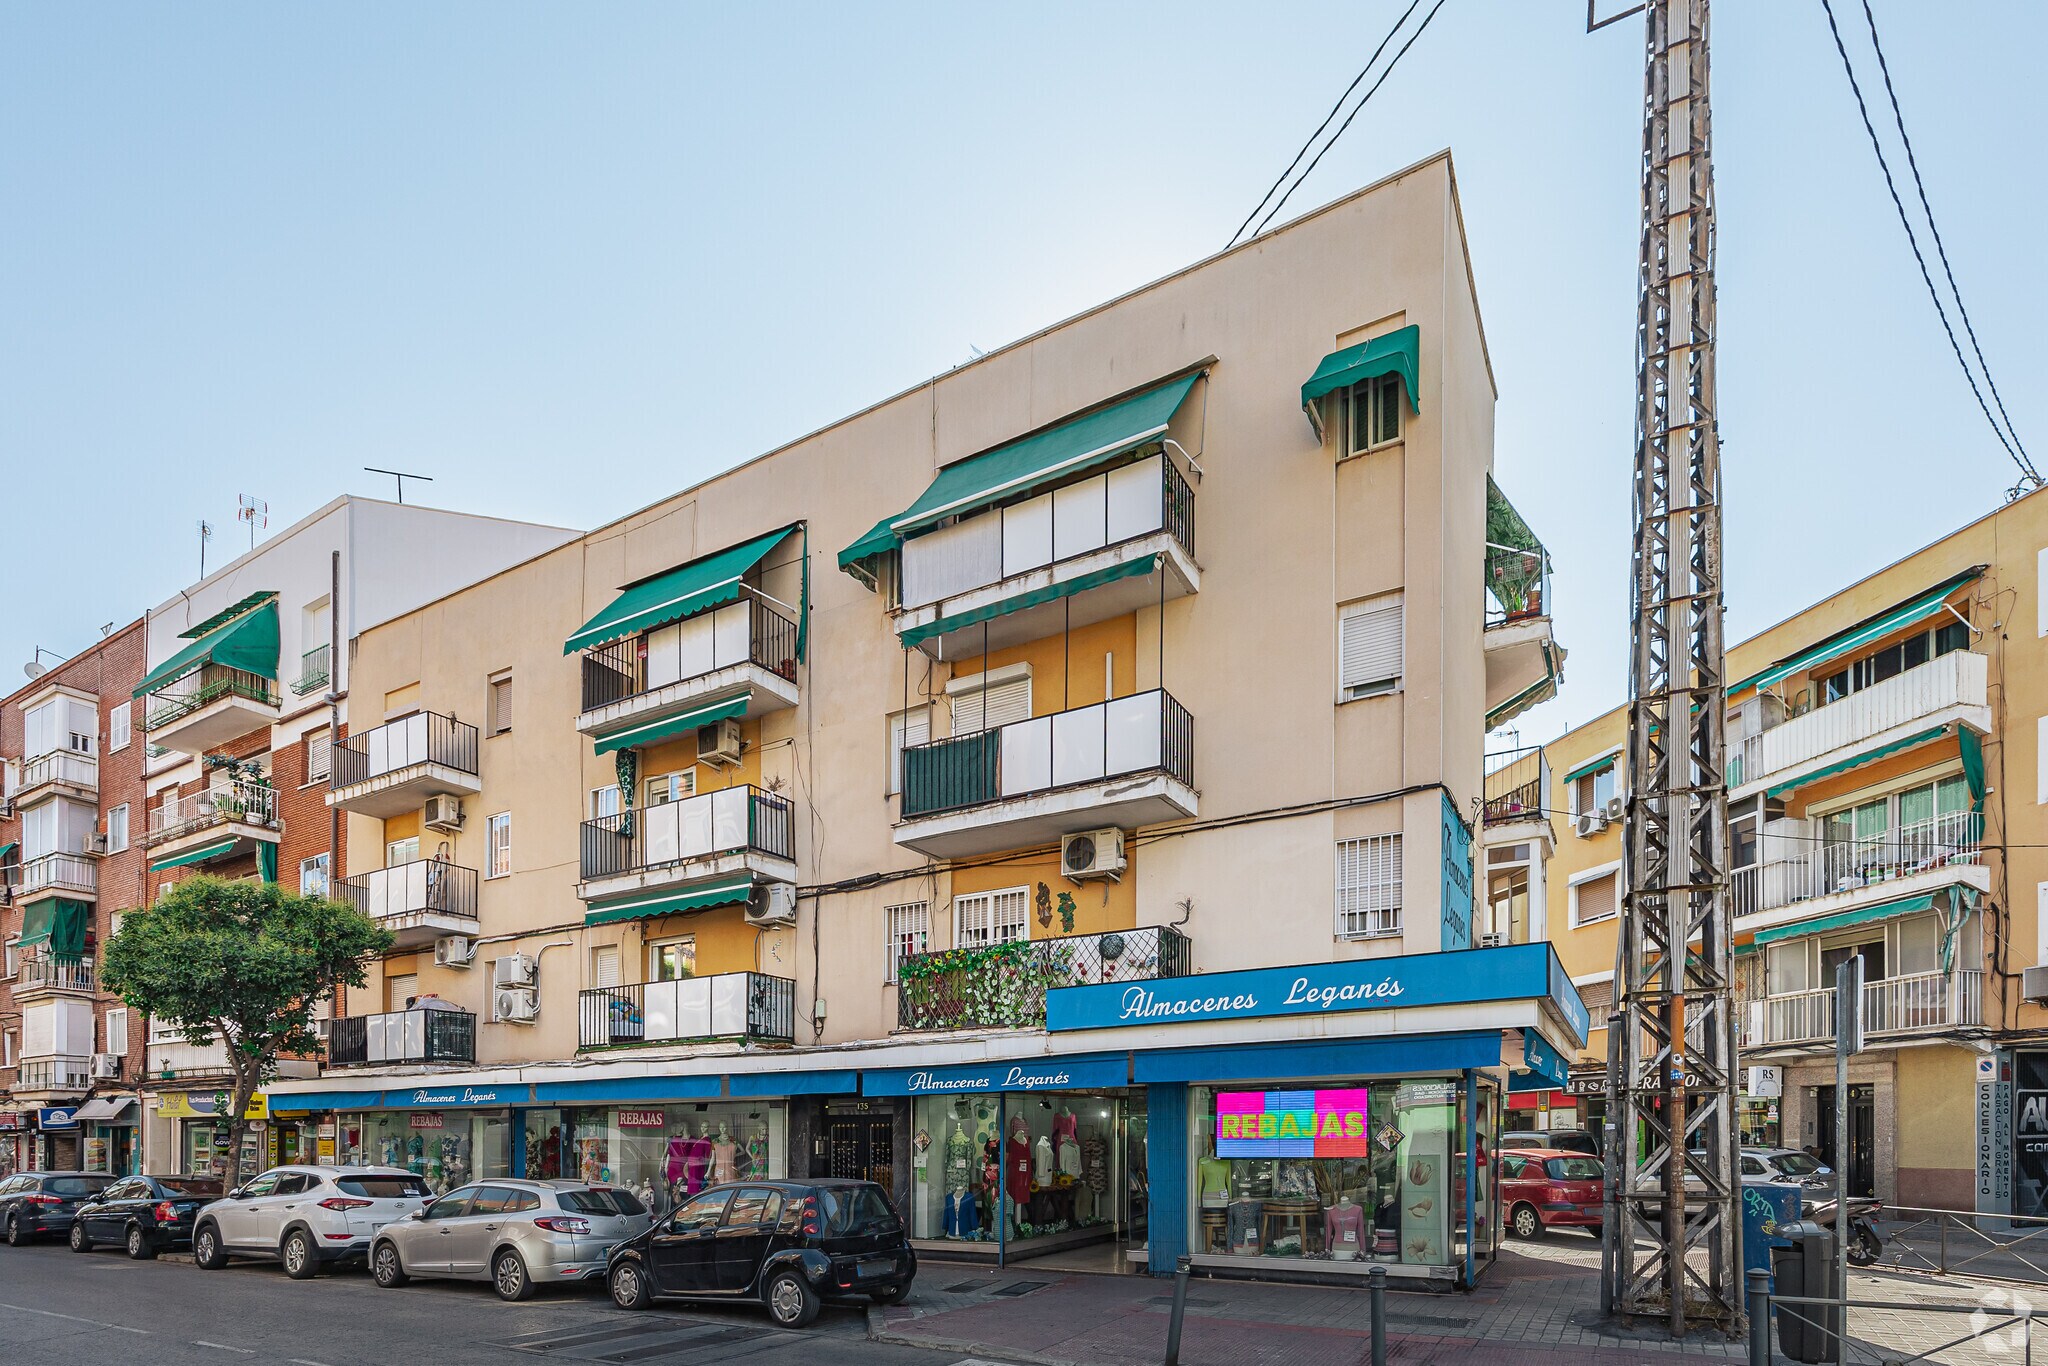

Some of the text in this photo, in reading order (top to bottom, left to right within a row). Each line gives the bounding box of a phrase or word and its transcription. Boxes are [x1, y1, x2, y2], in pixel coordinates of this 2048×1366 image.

[1119, 976, 1405, 1019] Almacenes Leganés
[908, 1066, 1069, 1091] Almacenes Leganés
[1762, 1069, 1774, 1080] RS
[413, 1087, 496, 1104] Almacenes Leganés
[857, 1102, 869, 1110] 135
[411, 1116, 443, 1127] REBAJAS
[620, 1112, 663, 1125] REBAJAS
[1222, 1111, 1365, 1139] REBAJAS
[2003, 1122, 2009, 1136] AL
[1981, 1084, 1991, 1195] CONCESIONARIO
